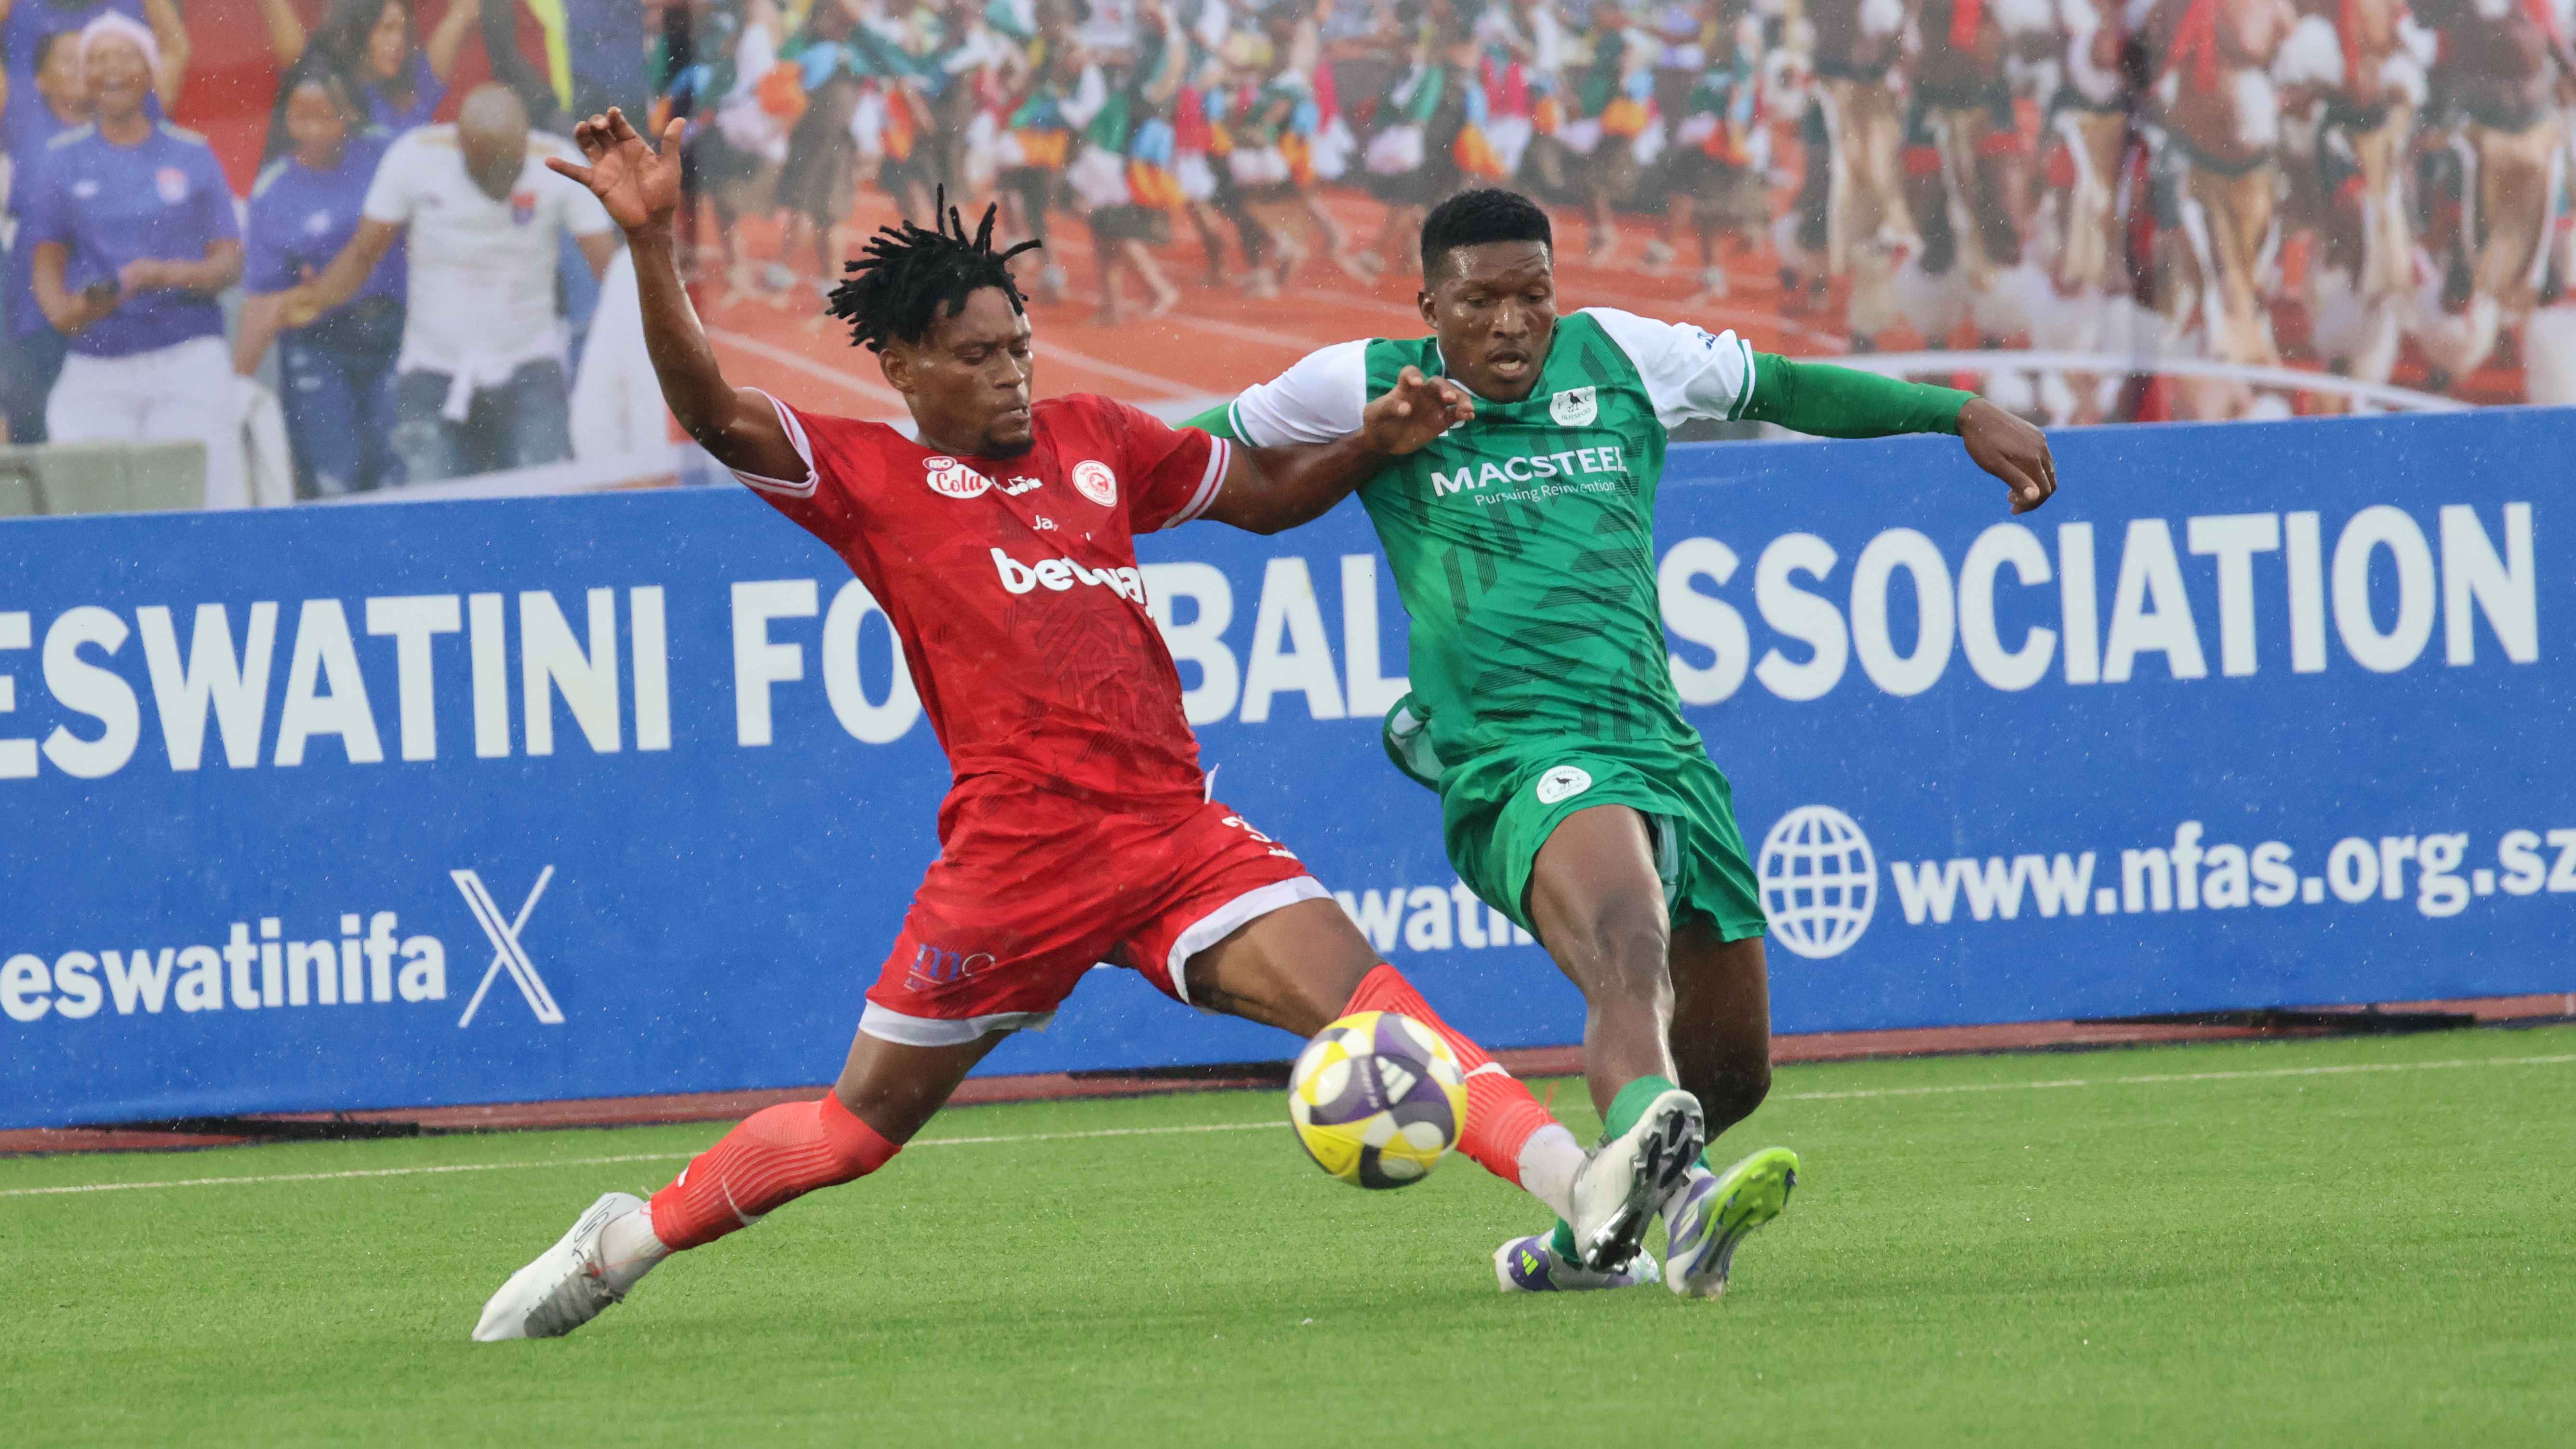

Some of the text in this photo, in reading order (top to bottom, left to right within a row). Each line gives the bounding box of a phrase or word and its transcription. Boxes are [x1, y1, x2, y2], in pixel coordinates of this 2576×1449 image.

[936, 469, 984, 492] Cola
[1430, 446, 1627, 497] MACSTEEL
[1474, 487, 1540, 506] Pursuing
[1541, 479, 1616, 497] Reinvention
[1657, 502, 2538, 705] SSOCIATION
[1891, 821, 2576, 925] www.nfas.org.sz
[0, 912, 446, 1022] eswatinifa
